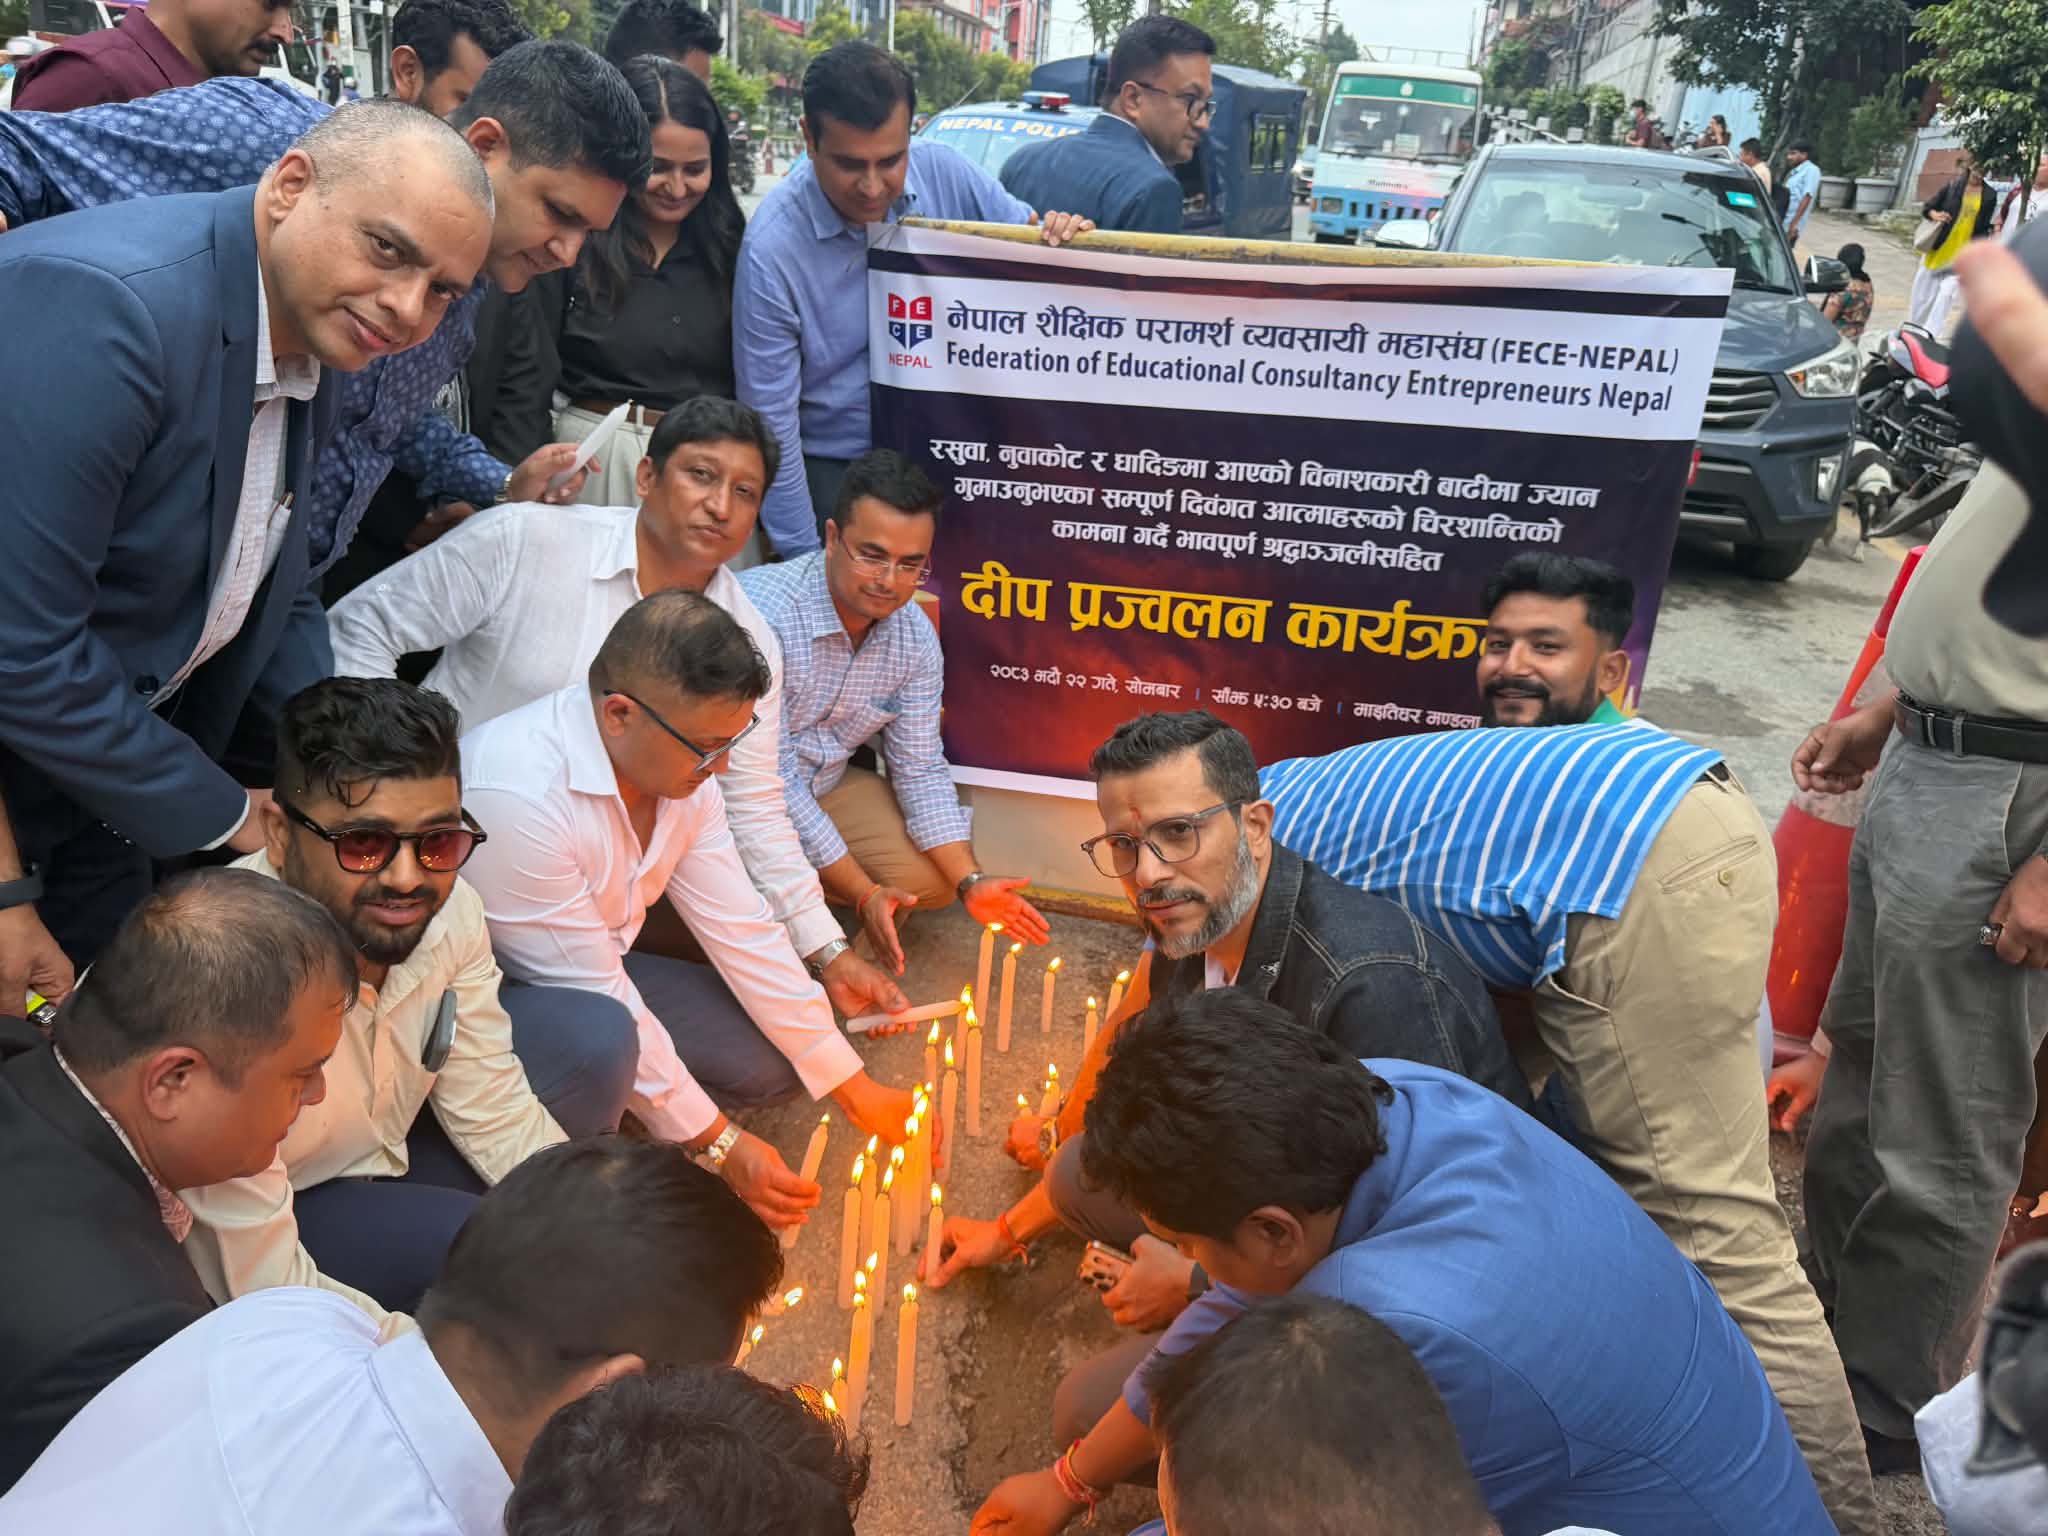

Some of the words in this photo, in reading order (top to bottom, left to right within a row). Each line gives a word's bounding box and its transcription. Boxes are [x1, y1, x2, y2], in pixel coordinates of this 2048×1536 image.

[936, 117, 1006, 132] NEPAL
[1010, 119, 1083, 139] POLI
[888, 352, 934, 369] NEPAL
[946, 300, 1028, 335] नेपाल
[1035, 304, 1127, 341] शैक्षिक
[1135, 316, 1235, 348] परामर्श
[1242, 322, 1369, 355] व्यवसायी
[1377, 330, 1489, 362] महासंघ
[1490, 336, 1680, 376] (FECE-NEPAL)
[947, 342, 1070, 374] Federation
[1076, 349, 1101, 375] of
[1106, 352, 1245, 385] Educational
[1251, 361, 1400, 399] Consultancy
[1407, 369, 1592, 406] Entrepreneurs
[1599, 382, 1672, 416] Nepal
[998, 443, 1084, 471] नुवाकोट
[1091, 450, 1108, 472] र
[1214, 459, 1293, 486] आएको
[1299, 460, 1432, 496] विनाशकारी
[1437, 473, 1523, 503] बाढीमा
[1527, 483, 1602, 509] ज्यान
[954, 476, 1096, 507] गुमाउनुभएका
[1101, 487, 1174, 516] सम्पूर्ण
[1180, 488, 1256, 520] दिवंगत
[1412, 506, 1565, 544] चिरशान्तिको
[1052, 519, 1127, 545] कामना
[1176, 528, 1258, 559] भावपूर्ण
[960, 560, 1053, 622] दीप
[1068, 580, 1273, 643] प्रज्वलन
[1286, 600, 1489, 661] कार्यक्र
[990, 664, 1030, 682] २०८३
[1065, 672, 1087, 689] २२
[1124, 676, 1183, 699] सोमबार
[1296, 694, 1324, 713] बजे
